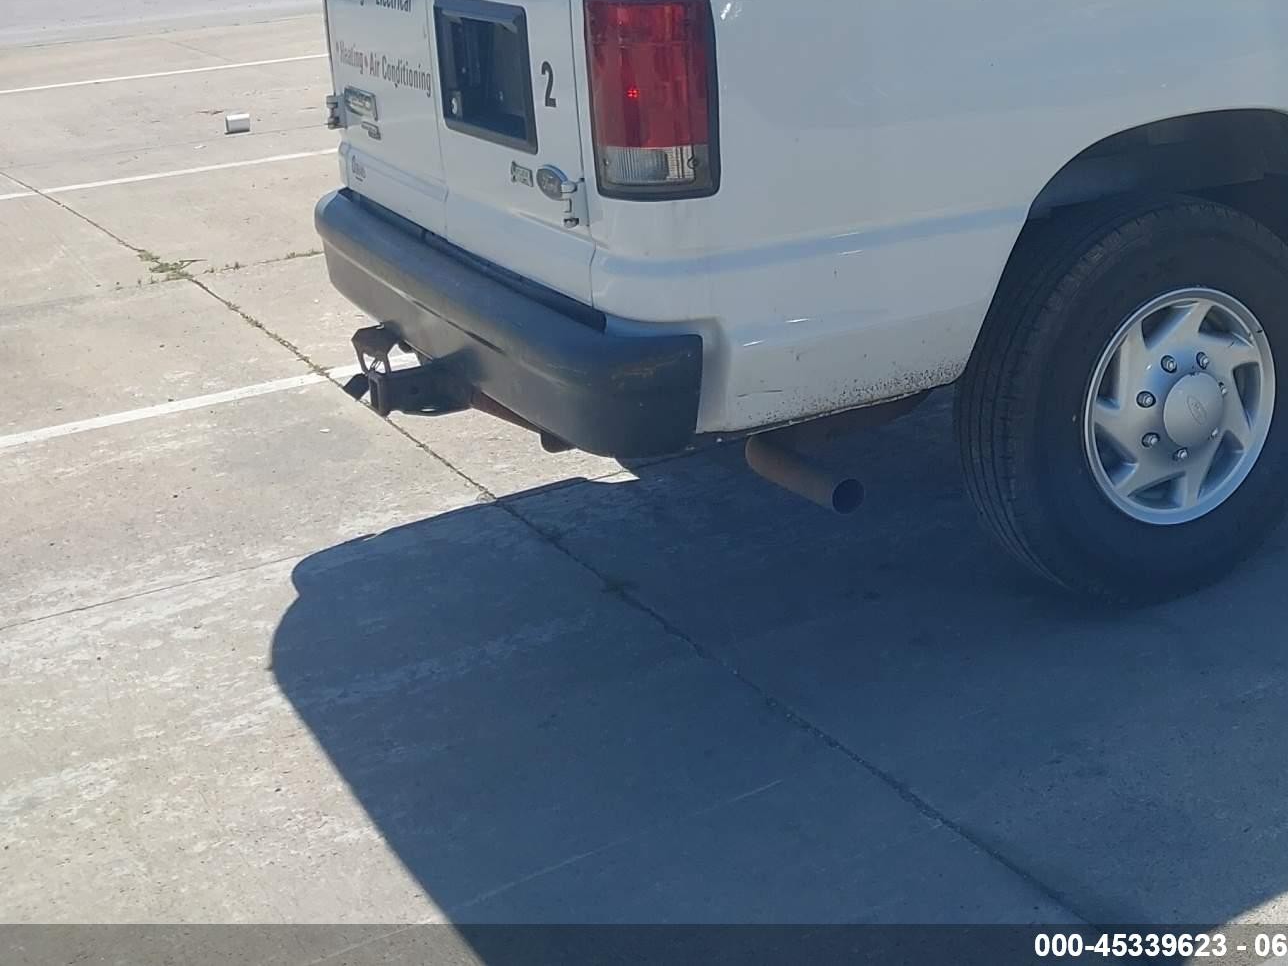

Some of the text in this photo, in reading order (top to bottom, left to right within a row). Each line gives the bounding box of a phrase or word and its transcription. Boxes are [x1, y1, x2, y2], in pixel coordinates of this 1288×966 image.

[339, 41, 432, 98] Heating Air Conditioning
[541, 61, 557, 108] 2
